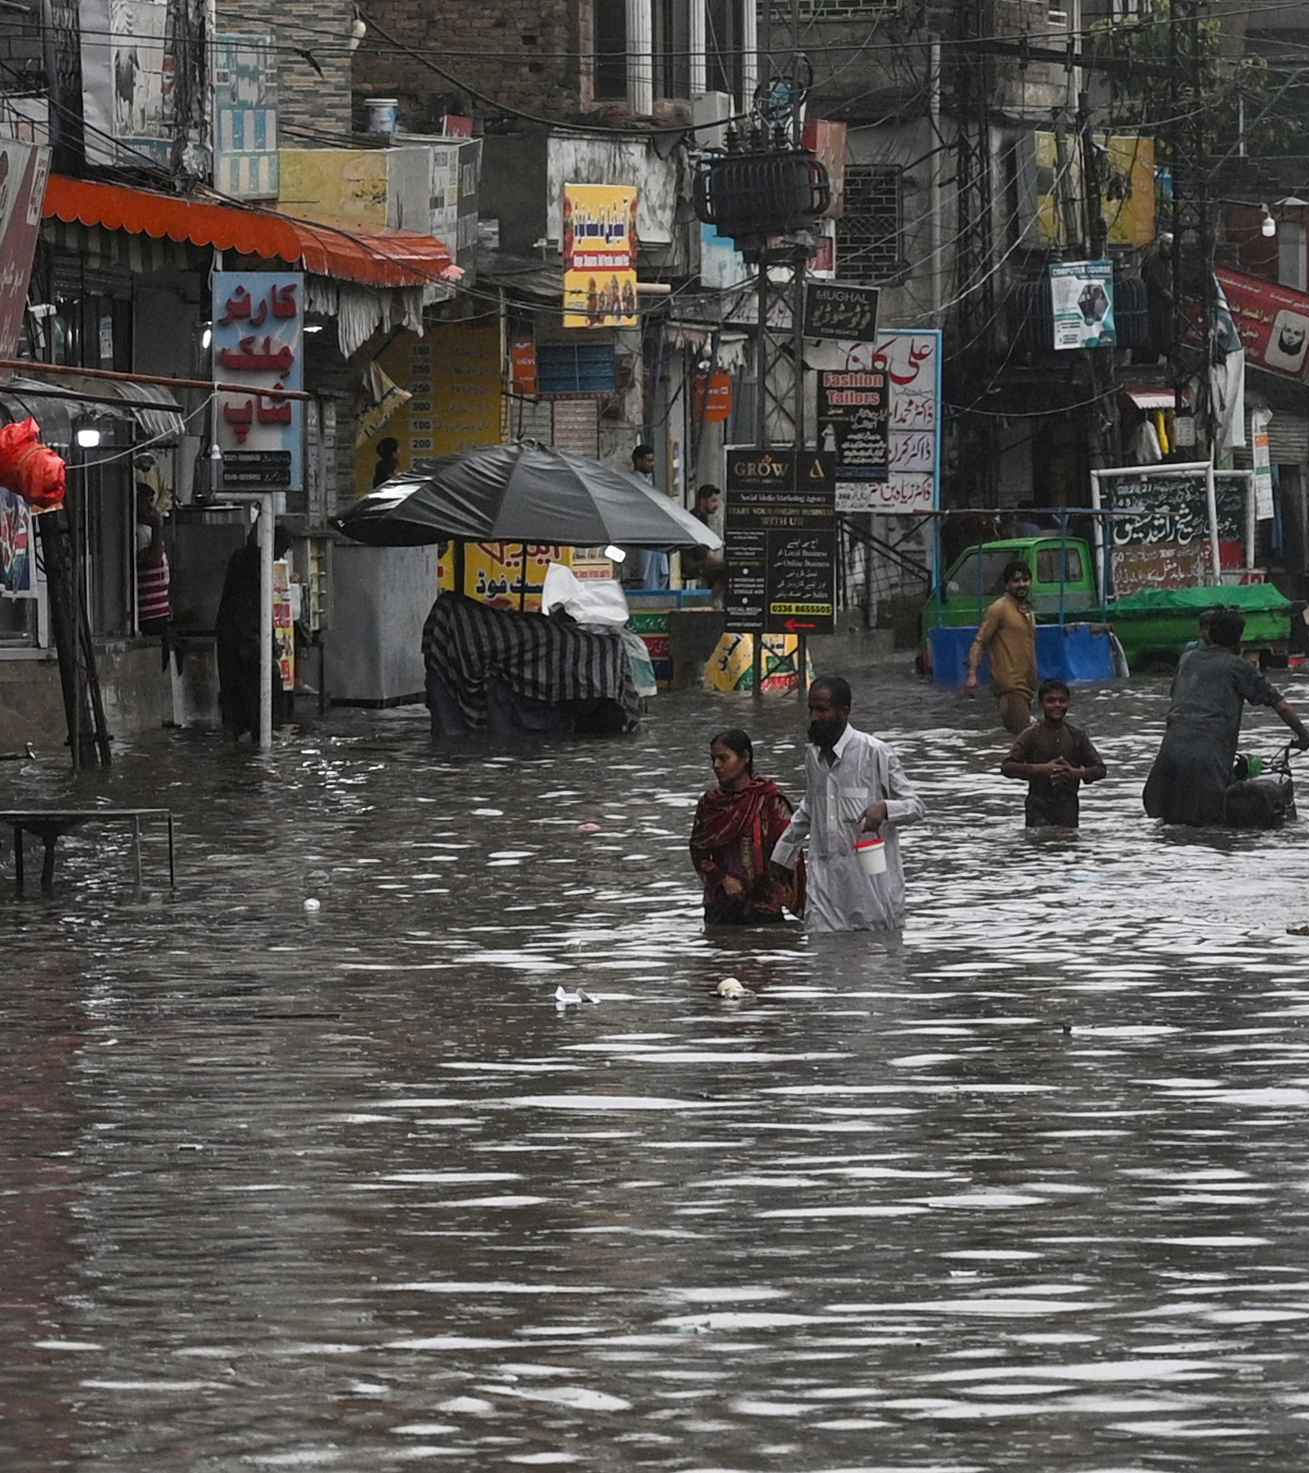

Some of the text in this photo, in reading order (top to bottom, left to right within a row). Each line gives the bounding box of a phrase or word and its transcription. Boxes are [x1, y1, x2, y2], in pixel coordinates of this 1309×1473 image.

[823, 372, 884, 387] Fashion
[826, 389, 880, 405] Tailors
[735, 462, 789, 477] GROW
